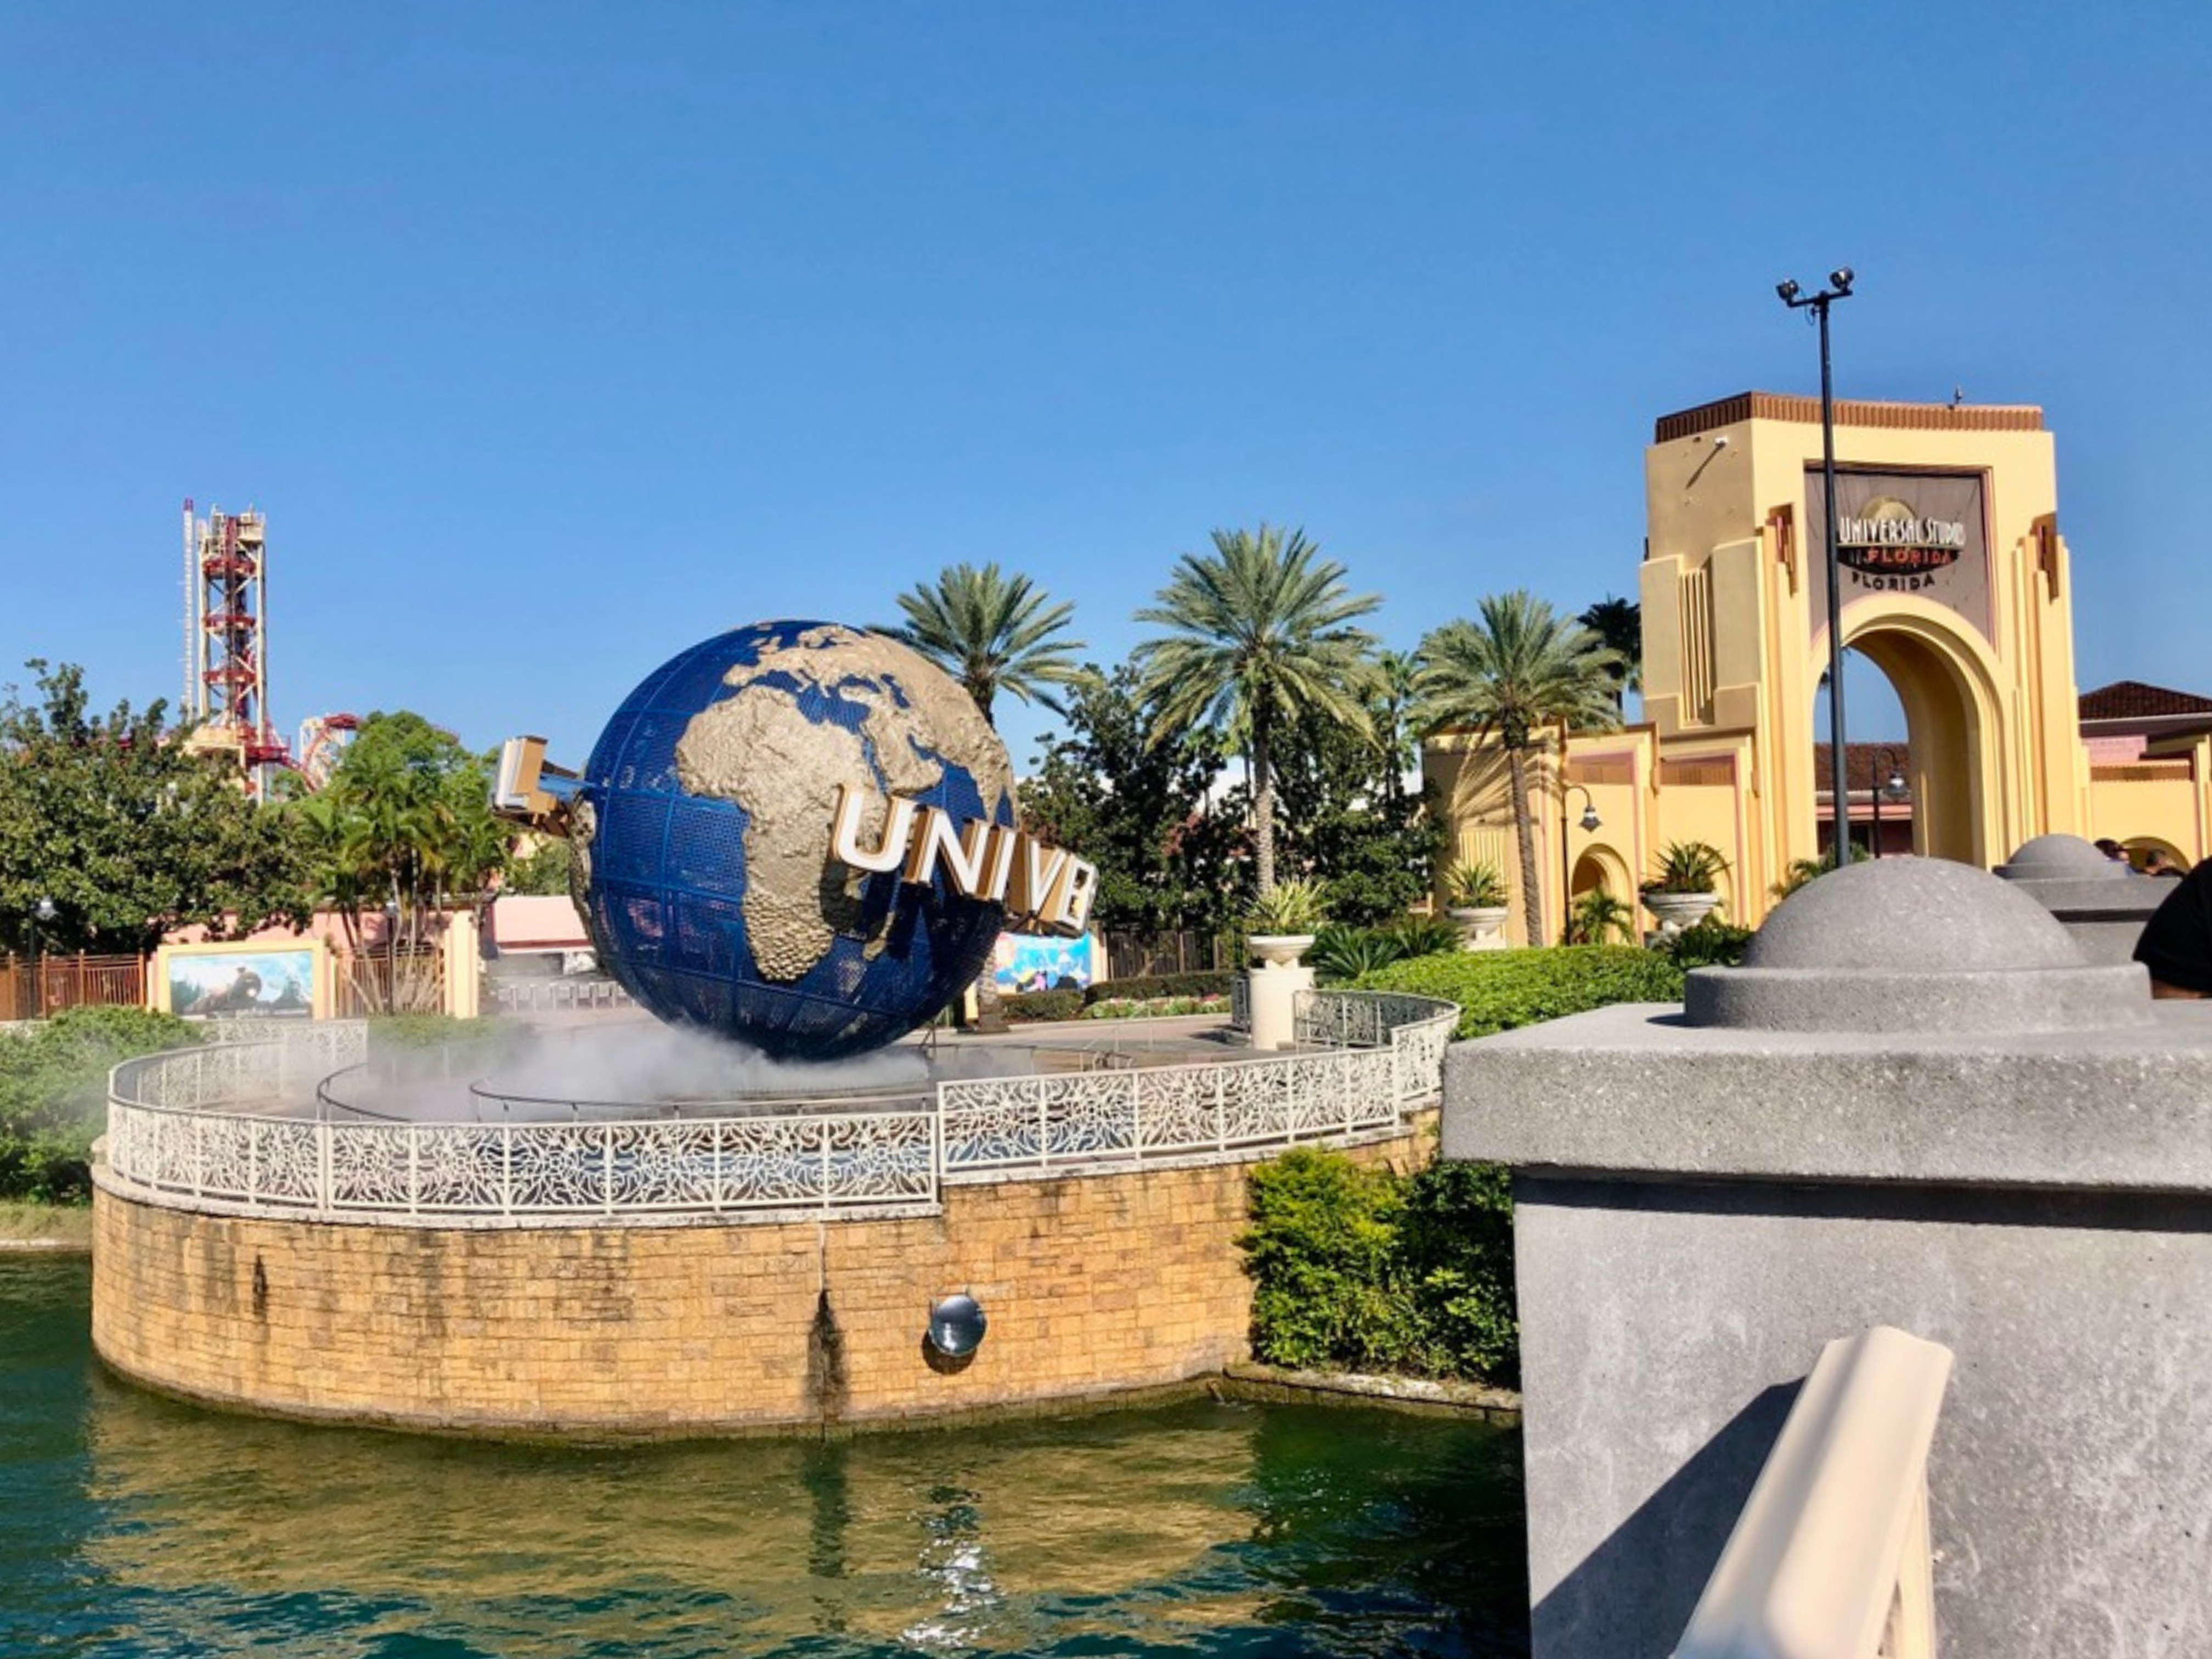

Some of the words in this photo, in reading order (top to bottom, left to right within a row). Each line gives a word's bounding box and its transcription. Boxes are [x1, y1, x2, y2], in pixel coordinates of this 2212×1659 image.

[1839, 517, 1924, 544] UNIVERSAL
[1866, 546, 1952, 565] FLORIDA
[1852, 571, 1936, 591] FLORIDA
[832, 785, 1099, 930] UNIVE
